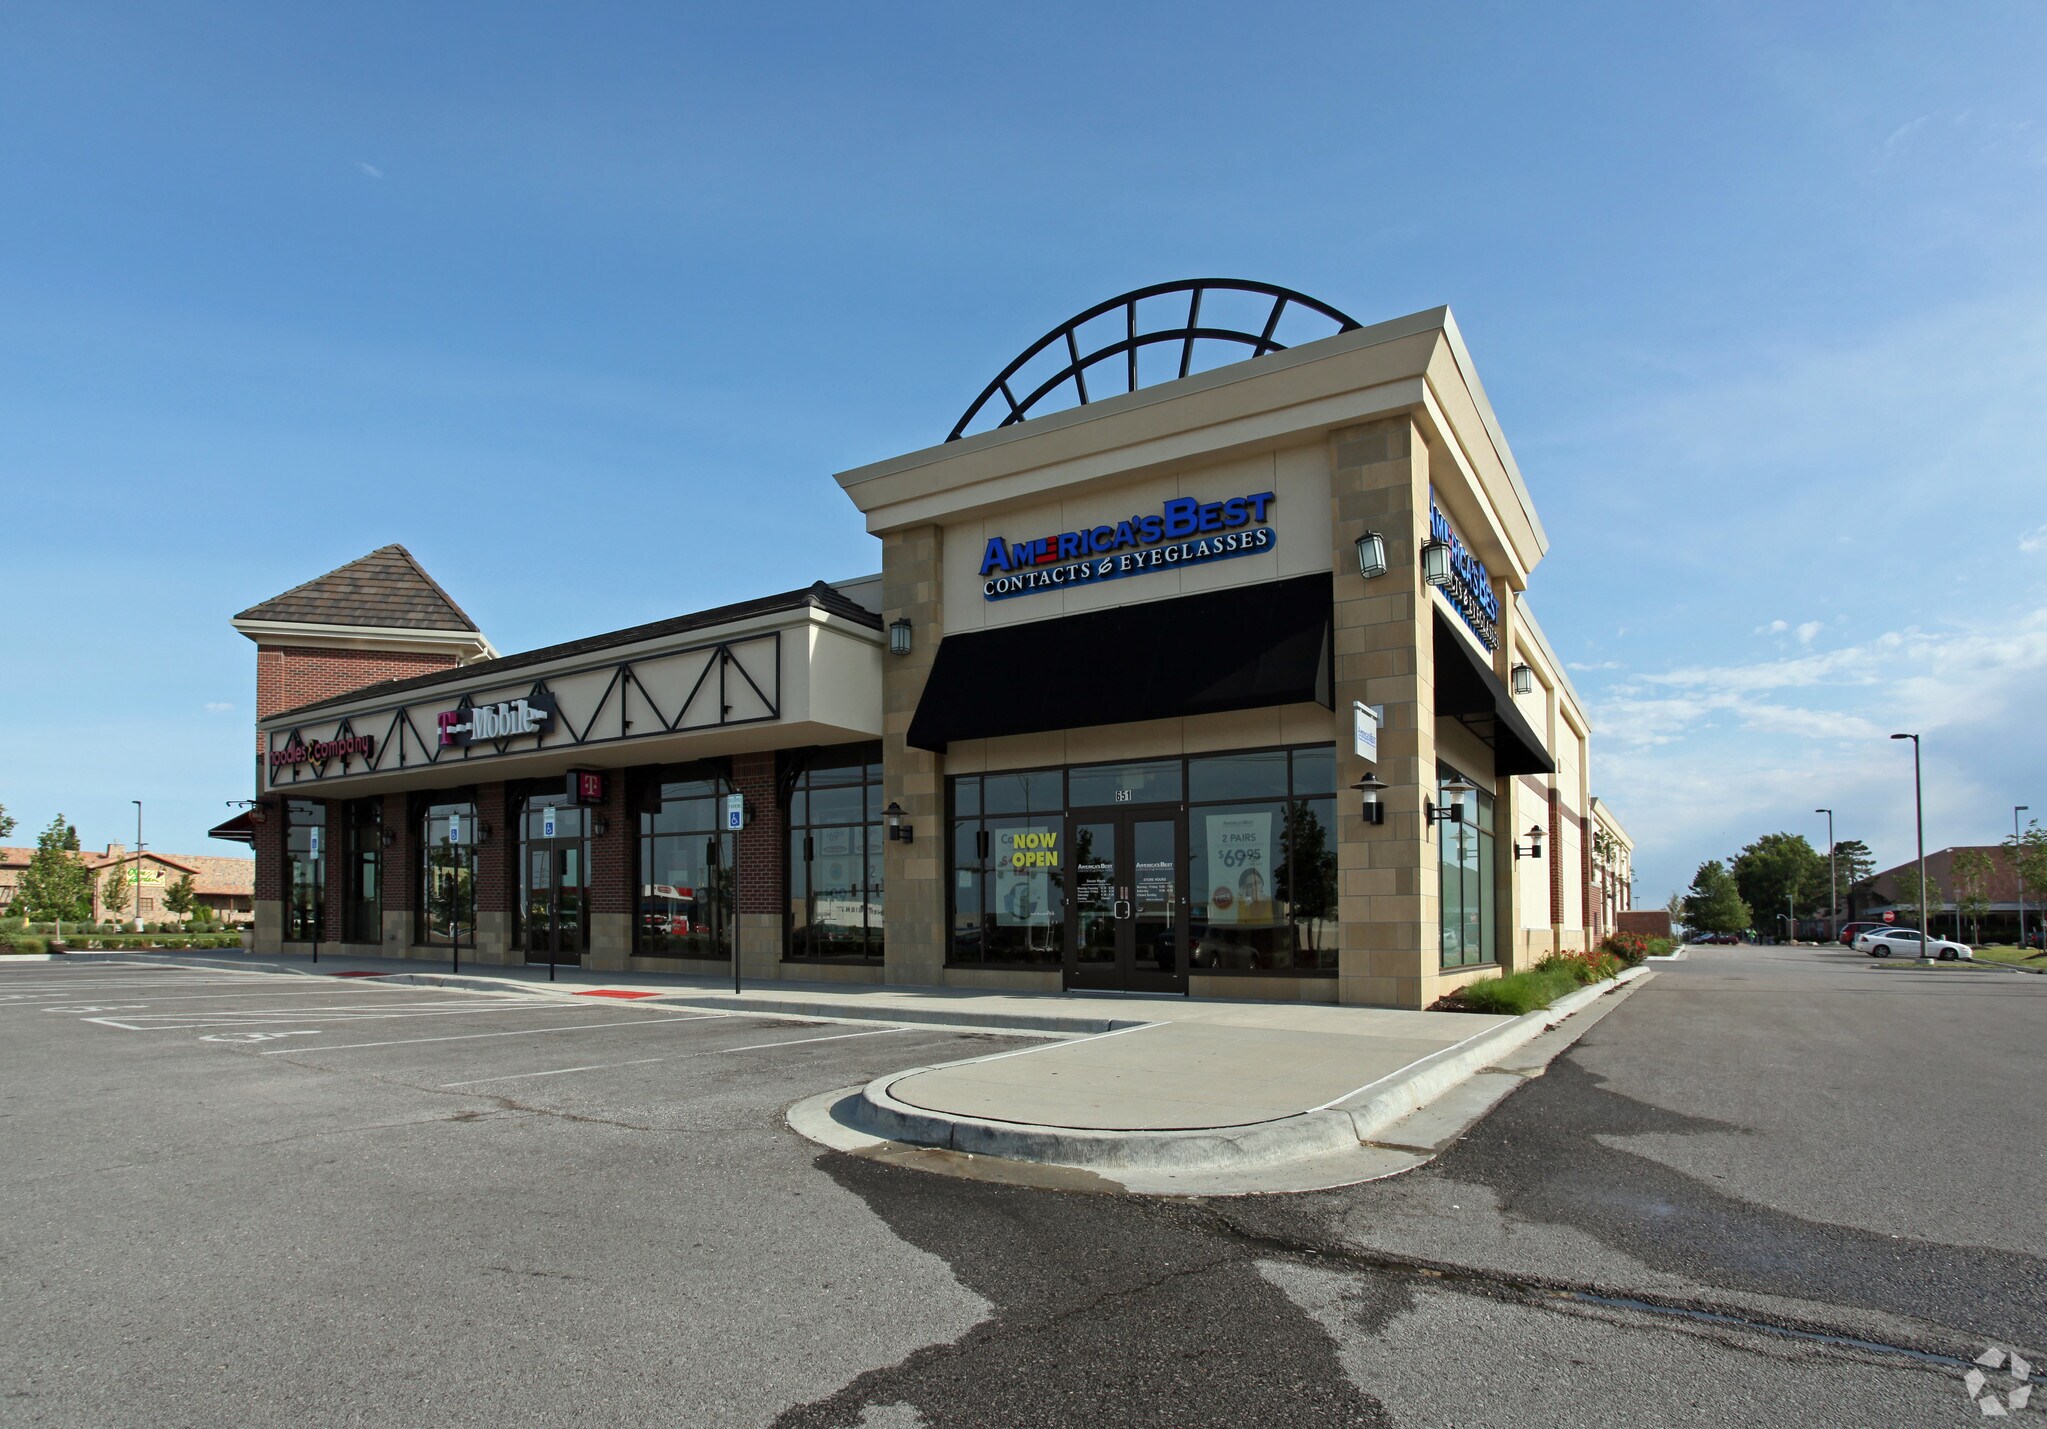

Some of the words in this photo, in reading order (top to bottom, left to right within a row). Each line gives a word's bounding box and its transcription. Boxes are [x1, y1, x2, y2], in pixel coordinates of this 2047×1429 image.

[983, 562, 1090, 597] CONTACTS
[1097, 557, 1113, 576] &
[1119, 529, 1268, 571] EYEGLASSES
[269, 739, 307, 766] noodles
[314, 736, 370, 759] company
[1116, 790, 1131, 801] 651
[1013, 832, 1057, 849] NOW
[1222, 834, 1228, 843] 2
[1230, 832, 1256, 843] PAIRS
[1012, 850, 1058, 868] OPEN
